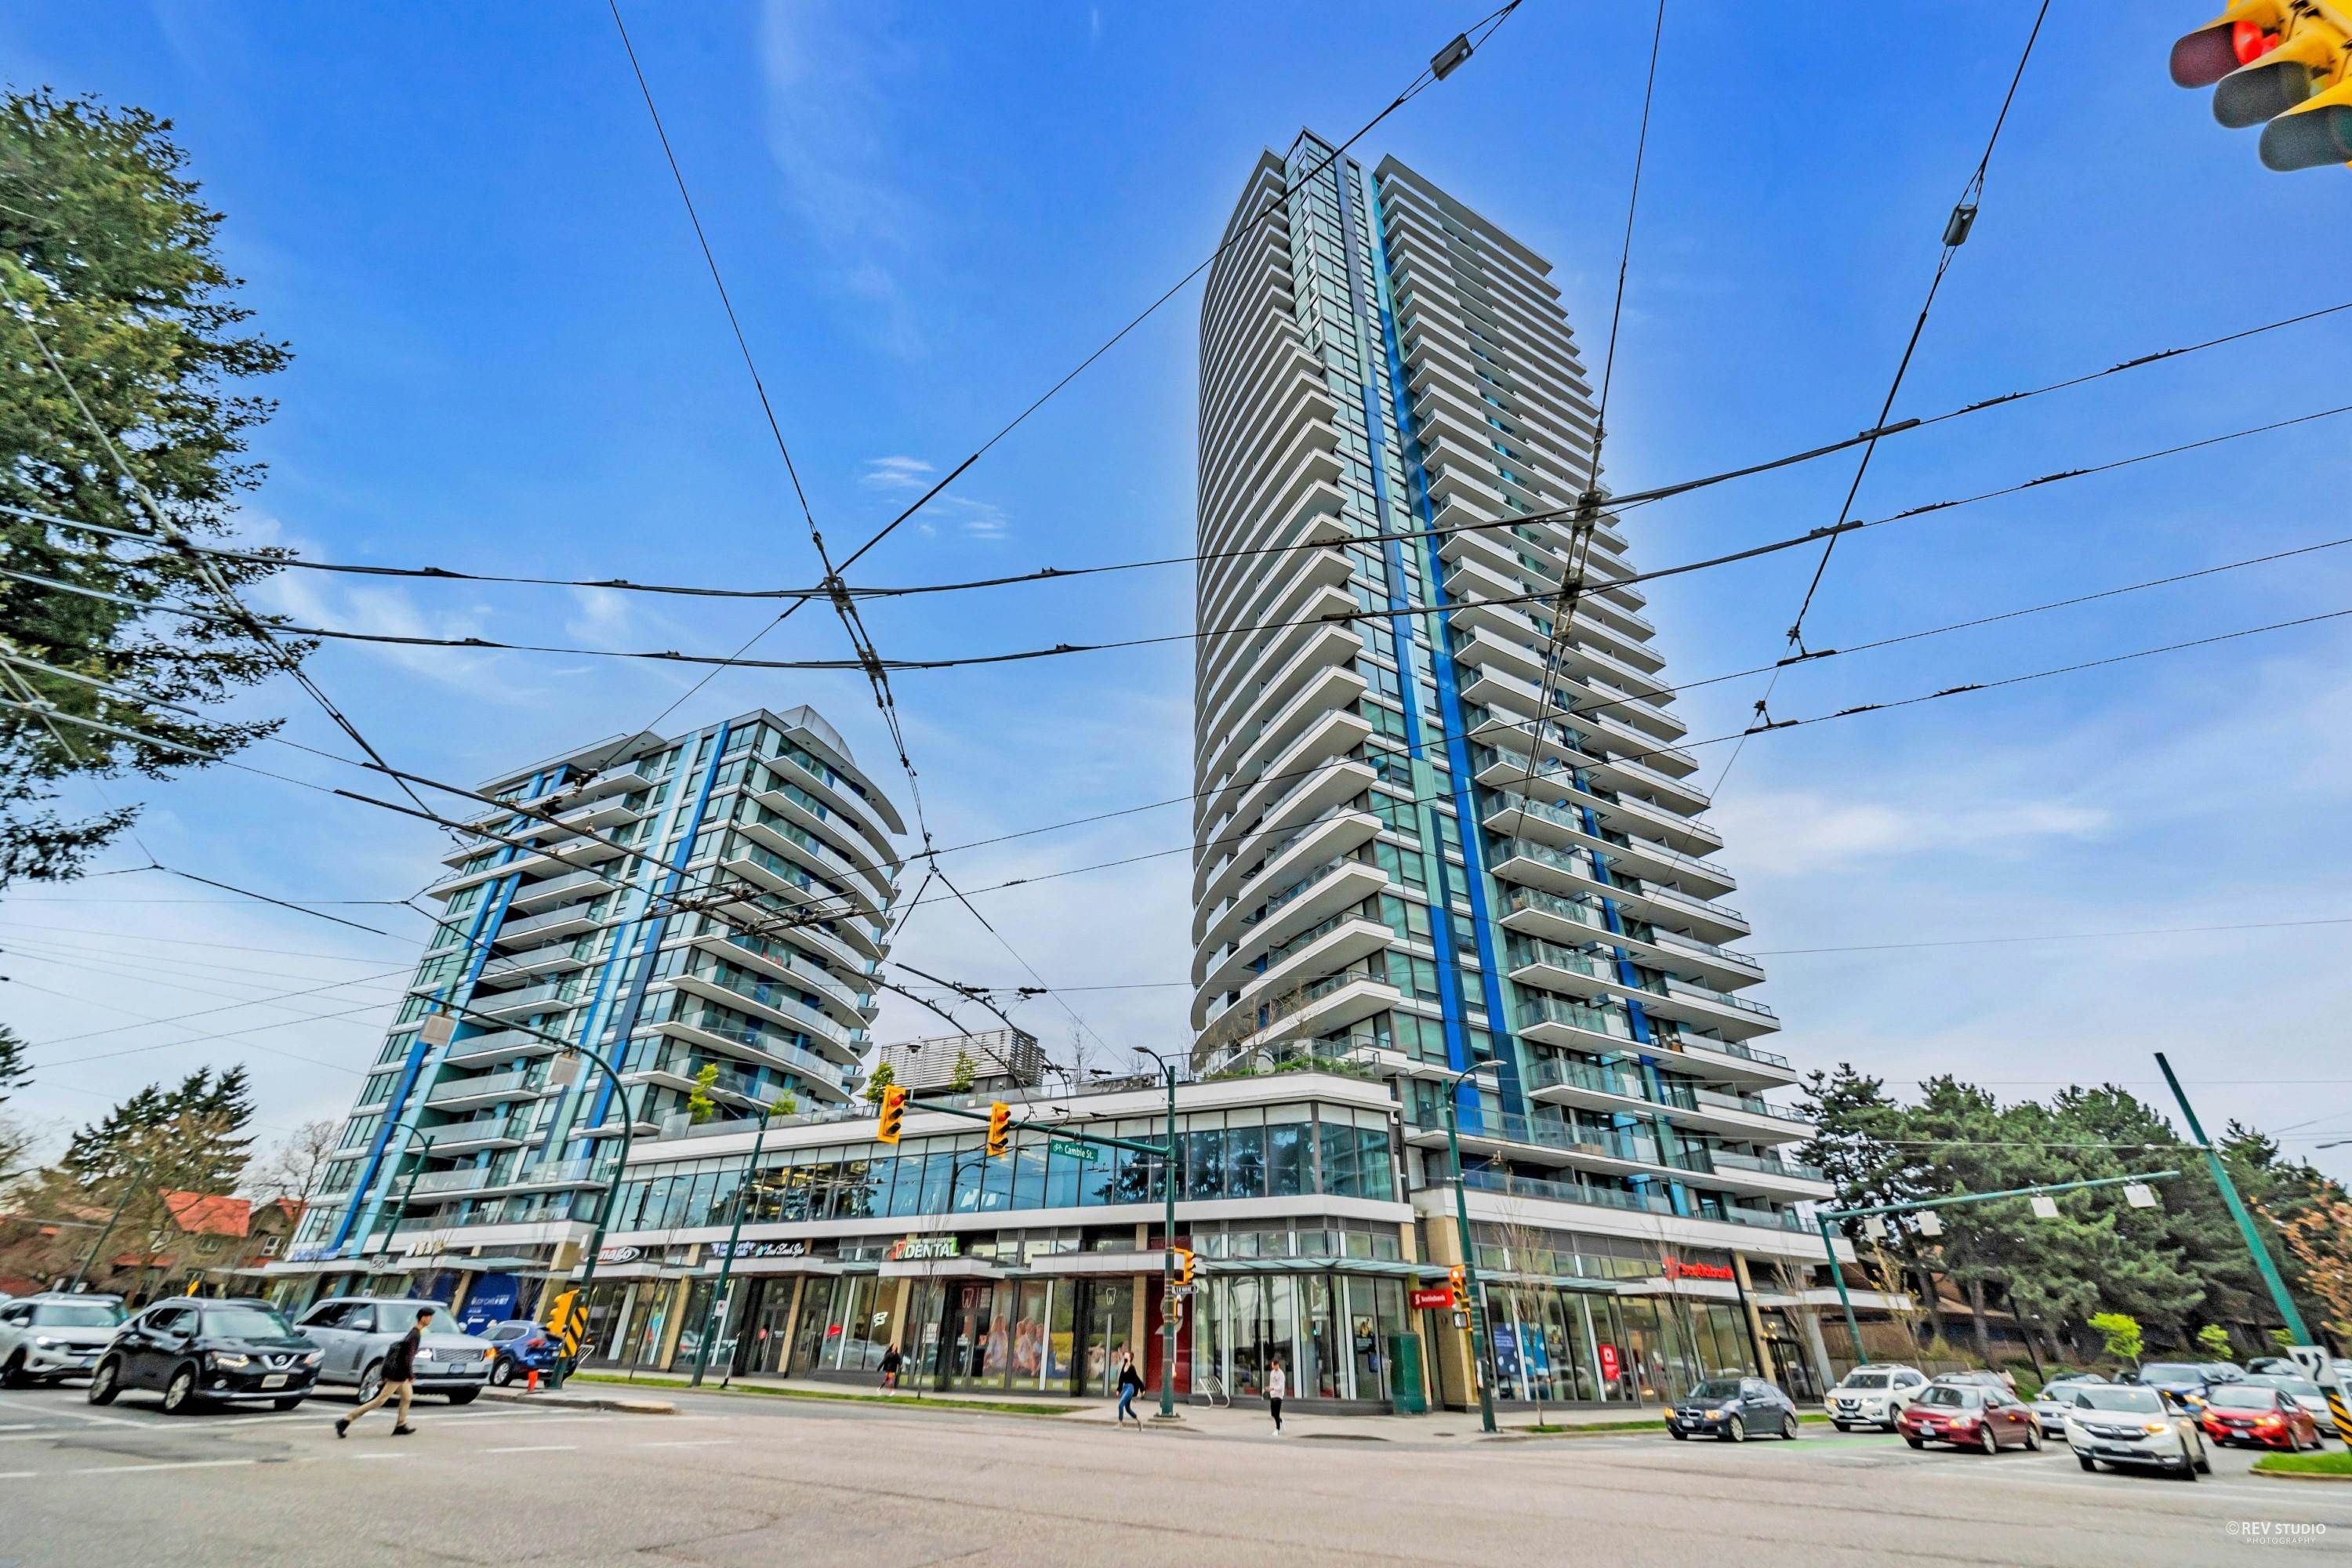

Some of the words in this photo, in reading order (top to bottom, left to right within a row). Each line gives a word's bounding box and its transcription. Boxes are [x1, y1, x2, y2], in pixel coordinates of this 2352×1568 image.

[1065, 1145, 1085, 1157] Cambie
[1086, 1149, 1094, 1160] St.
[905, 1243, 960, 1258] DENTAL
[372, 1259, 385, 1269] 50
[1421, 1294, 1446, 1303] Scotiabank
